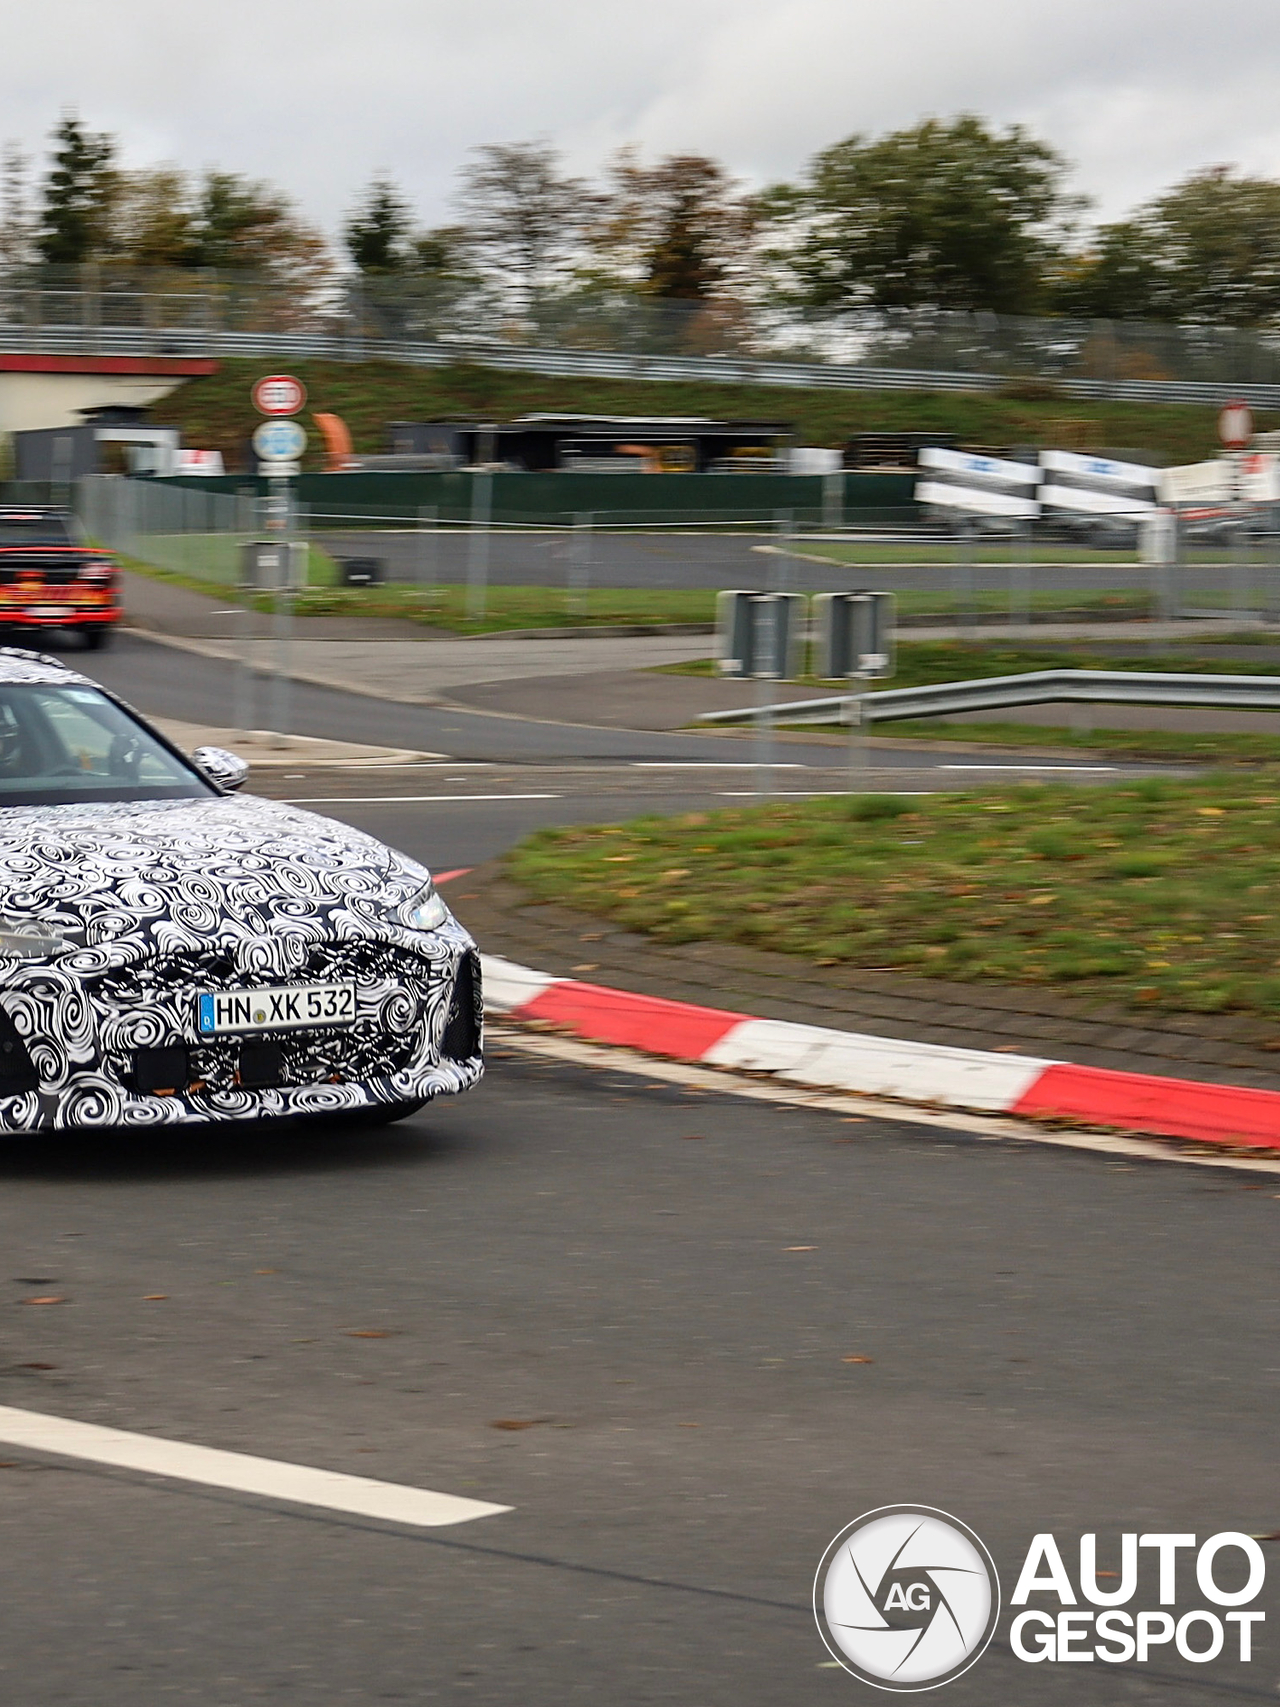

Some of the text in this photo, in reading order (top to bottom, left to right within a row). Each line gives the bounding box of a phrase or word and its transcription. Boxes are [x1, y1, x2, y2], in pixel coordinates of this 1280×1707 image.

[217, 989, 352, 1025] HN XK 532
